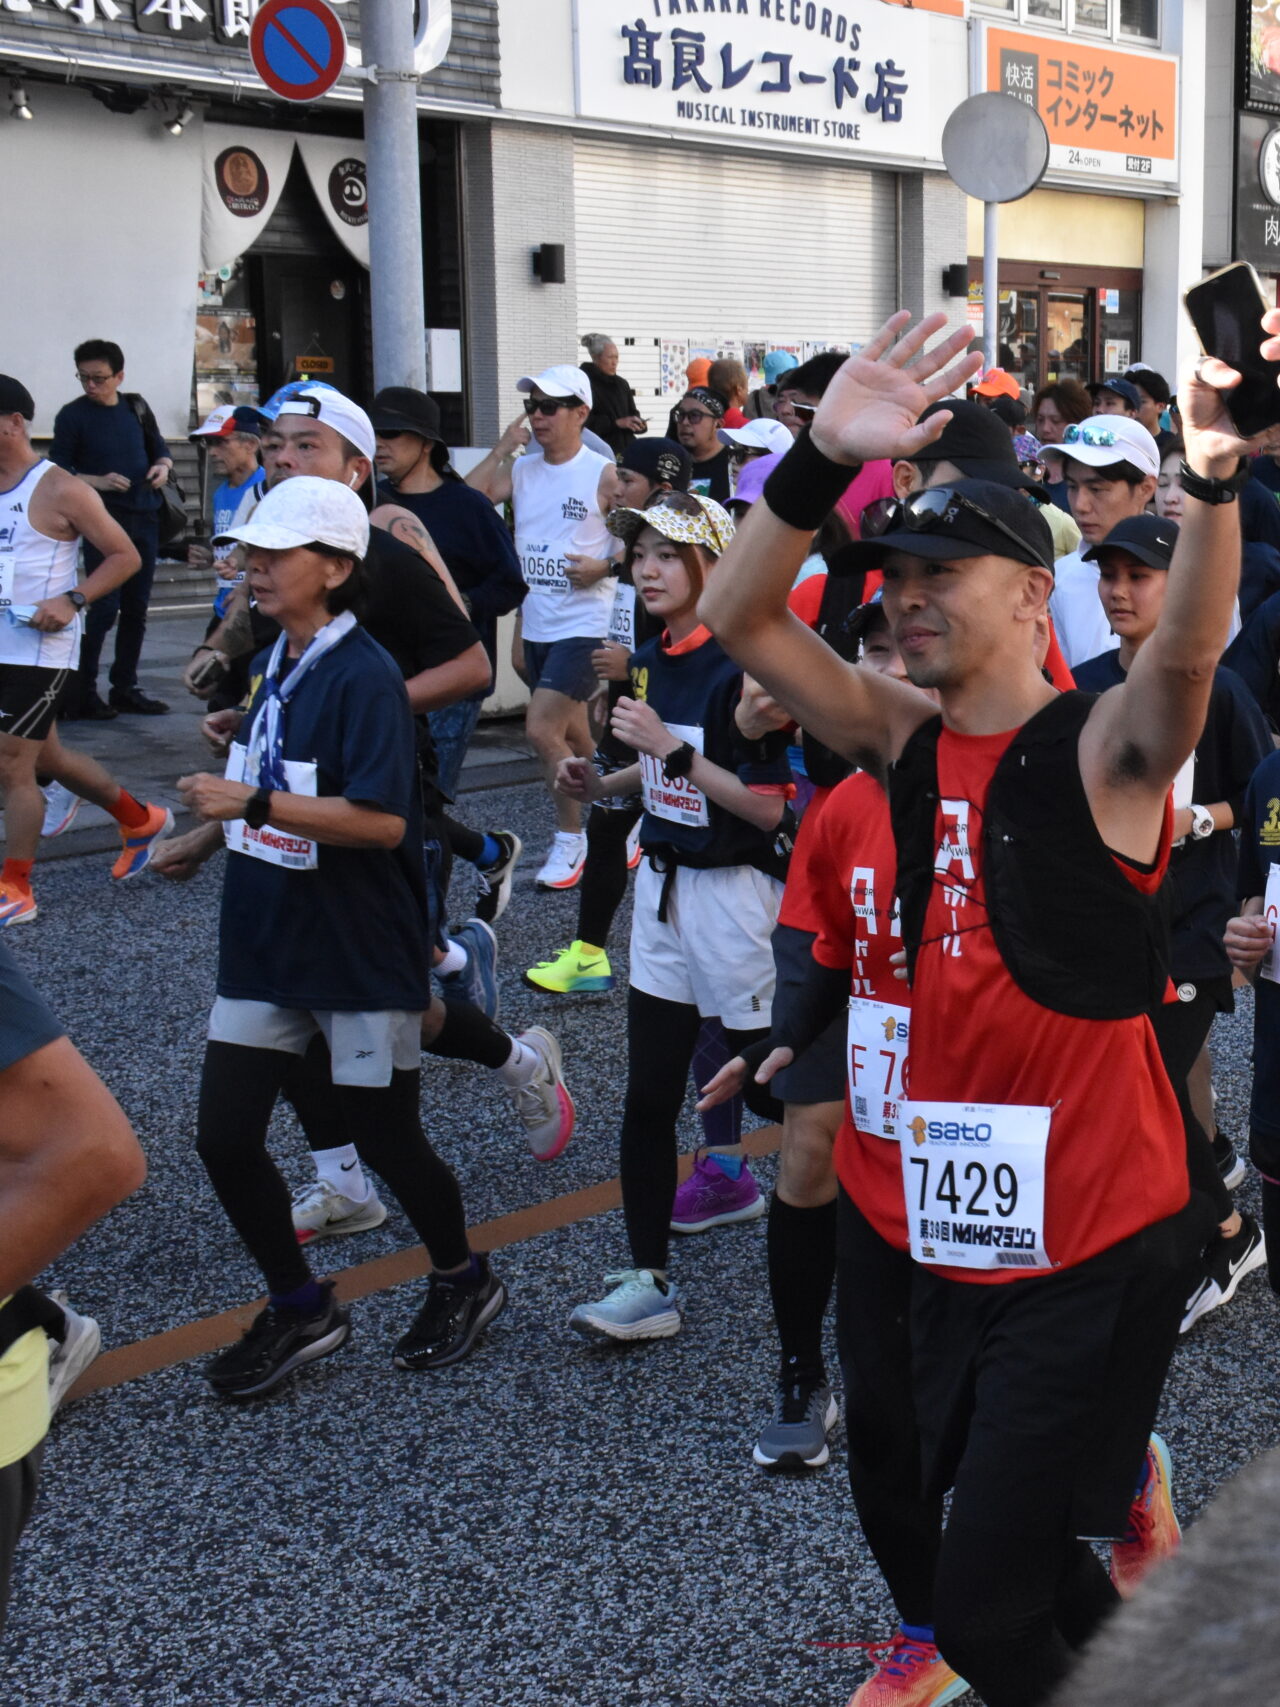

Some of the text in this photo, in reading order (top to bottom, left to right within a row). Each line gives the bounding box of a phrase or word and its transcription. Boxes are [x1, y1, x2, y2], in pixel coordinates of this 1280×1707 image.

[759, 0, 862, 52] RECORDS
[1005, 61, 1035, 90] 快活
[1046, 59, 1115, 98] コミック
[1006, 91, 1034, 107] UB
[676, 100, 861, 141] MUSICAL INSTRUMENT STORE
[1046, 95, 1164, 141] インターネット
[561, 503, 588, 514] North
[562, 511, 587, 520] Face
[567, 497, 584, 507] The
[525, 544, 543, 553] ANA
[518, 556, 568, 578] 10565
[851, 1043, 867, 1088] F
[909, 1156, 1018, 1218] 7429
[920, 1218, 1036, 1250] 第39回 NAHAマラソン
